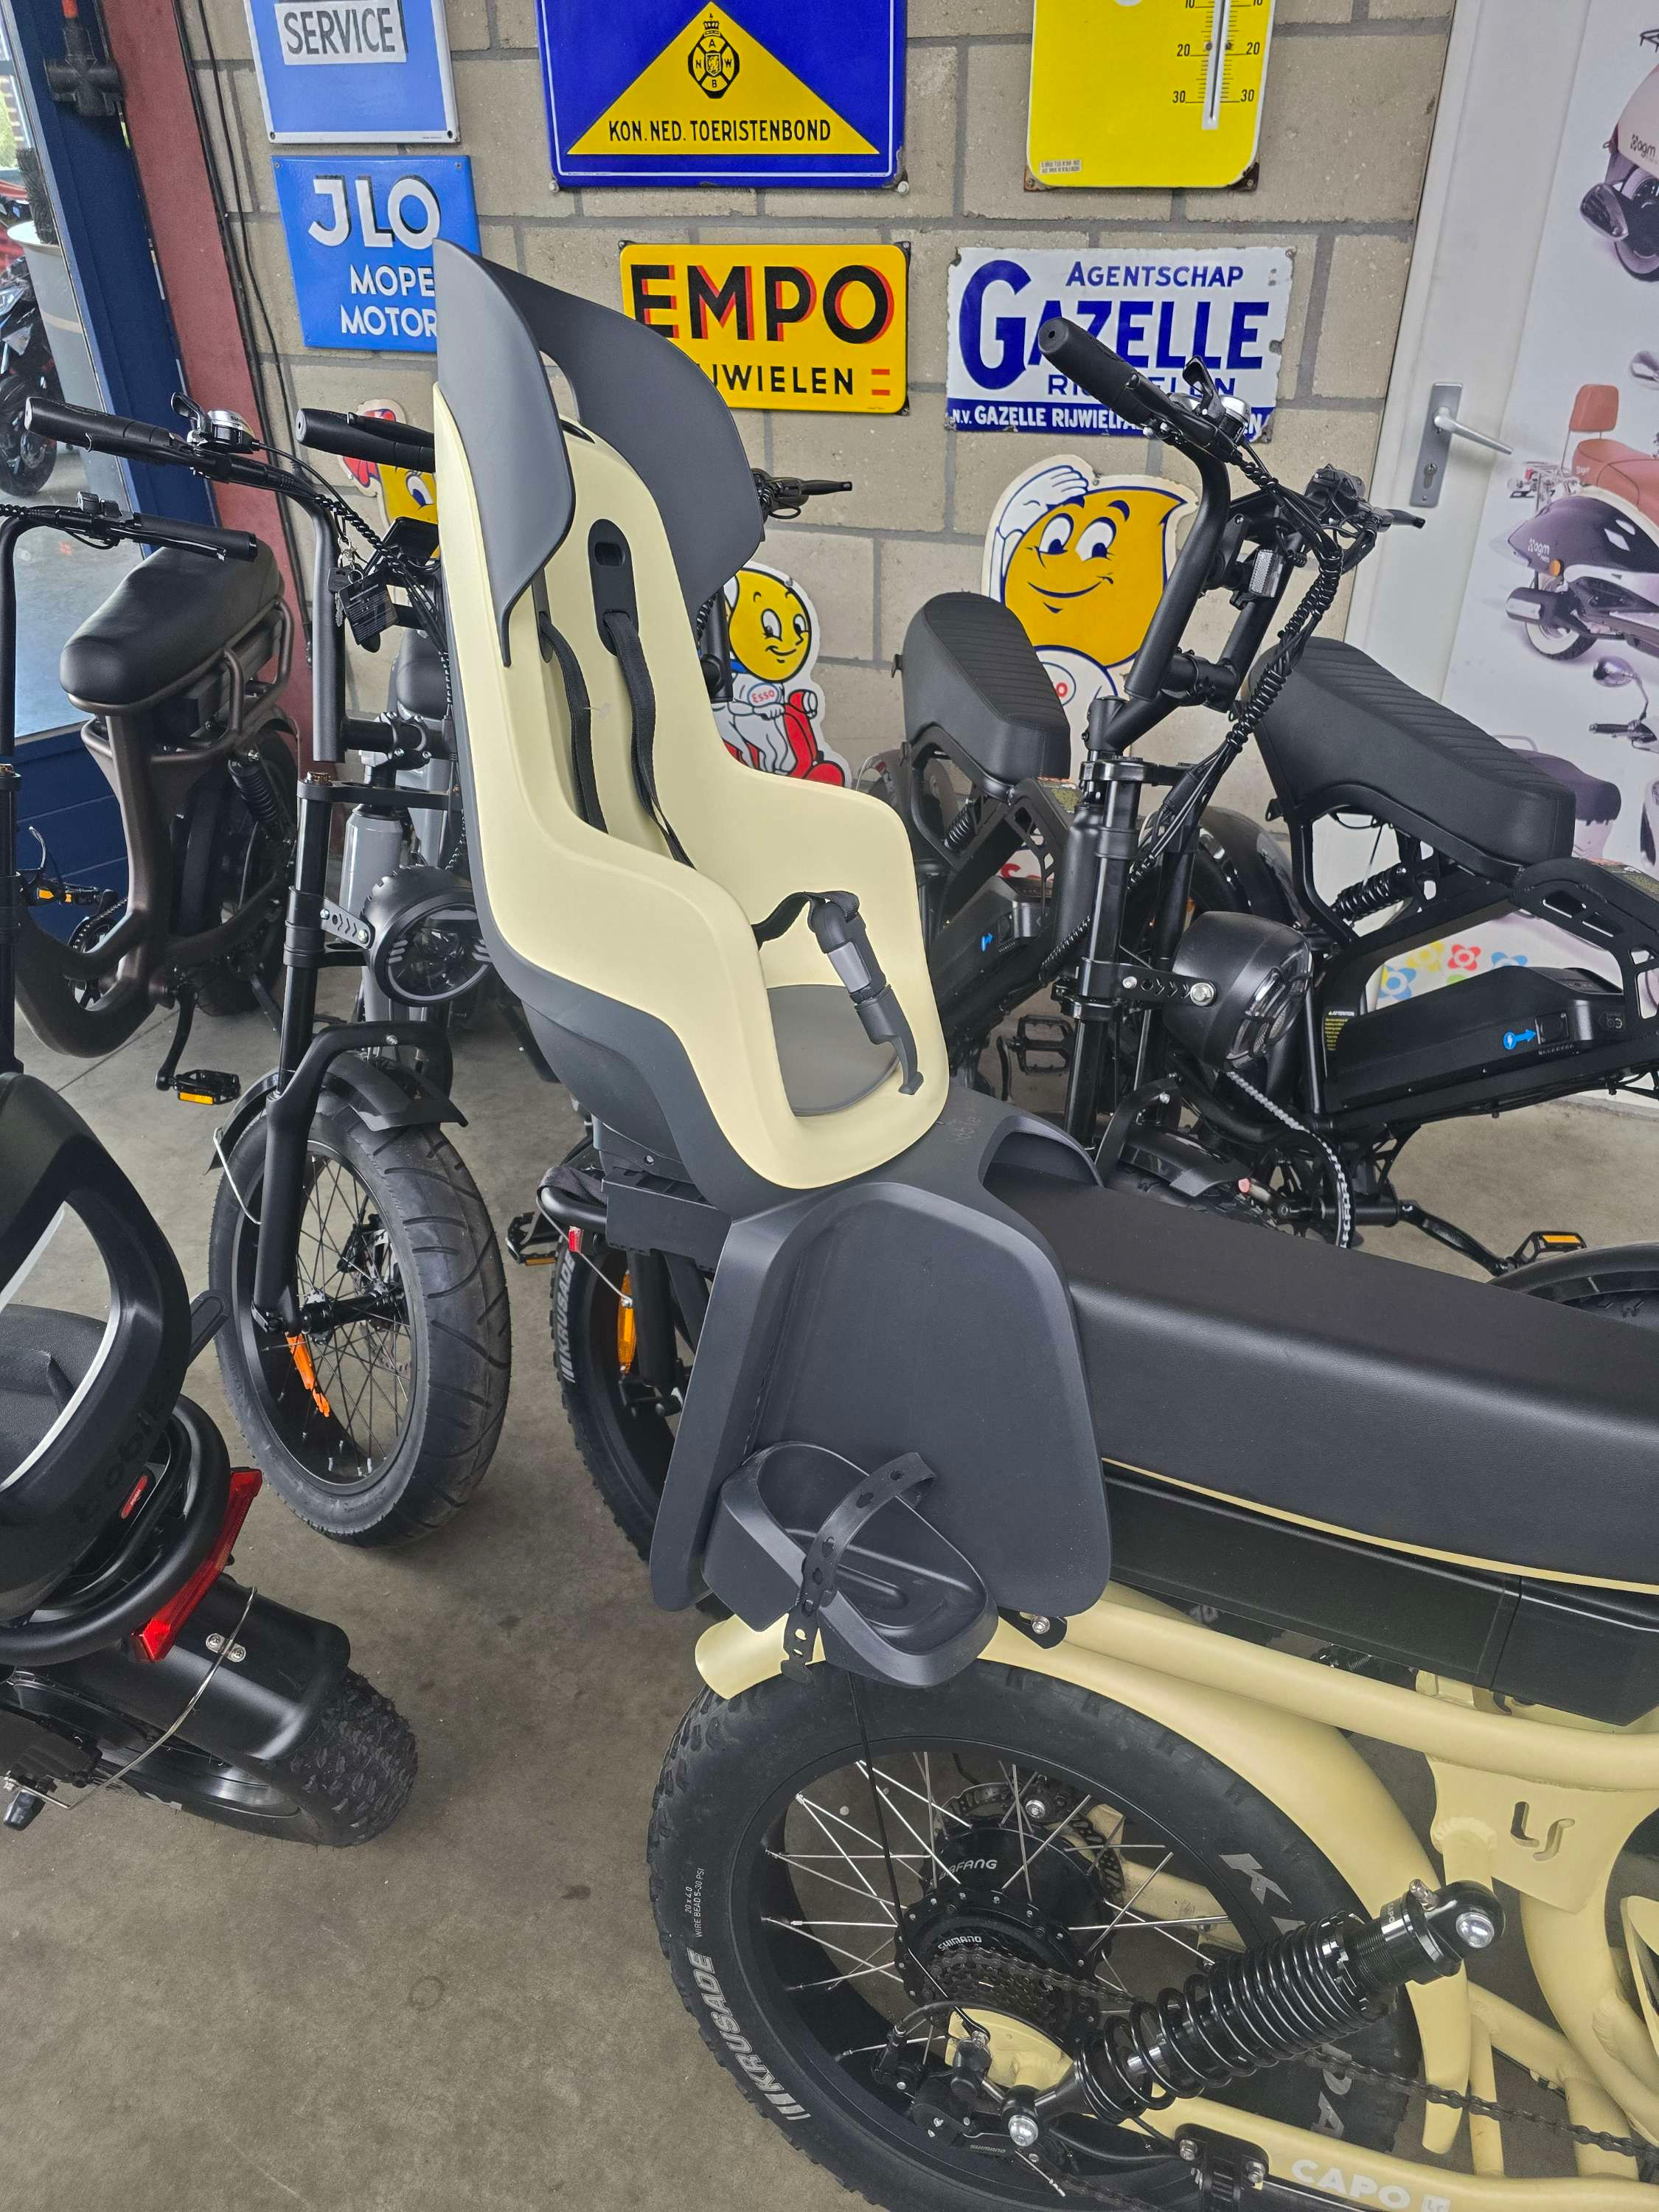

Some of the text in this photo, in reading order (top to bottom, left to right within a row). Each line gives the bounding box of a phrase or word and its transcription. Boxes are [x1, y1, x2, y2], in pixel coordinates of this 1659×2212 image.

[283, 7, 395, 55] SERVICE
[1176, 44, 1191, 57] 20
[1245, 41, 1261, 55] 20
[1172, 90, 1186, 103] 30
[1240, 88, 1255, 102] 30
[608, 119, 831, 142] KON. NED. TOERISTENBOND
[308, 175, 441, 250] JLO
[349, 264, 436, 297] MOPE
[1065, 261, 1244, 288] AGENTSCHAP
[630, 264, 894, 344] EMPO
[340, 304, 437, 337] MOTOR
[959, 260, 1270, 390] GAZELLE
[951, 408, 973, 425] N.V.
[974, 405, 1048, 428] GAZELLE
[557, 1250, 576, 1357] KRUSADE
[685, 1886, 693, 1899] 4.0
[693, 1868, 706, 1938] WIRE BEAD 5-30 PSI
[685, 1904, 692, 1914] 20
[937, 1935, 983, 1951] SHIMANO
[686, 1947, 785, 2092] KRUSADE
[970, 2144, 1006, 2154] SHIMANO
[1291, 2159, 1411, 2209] CAPO
